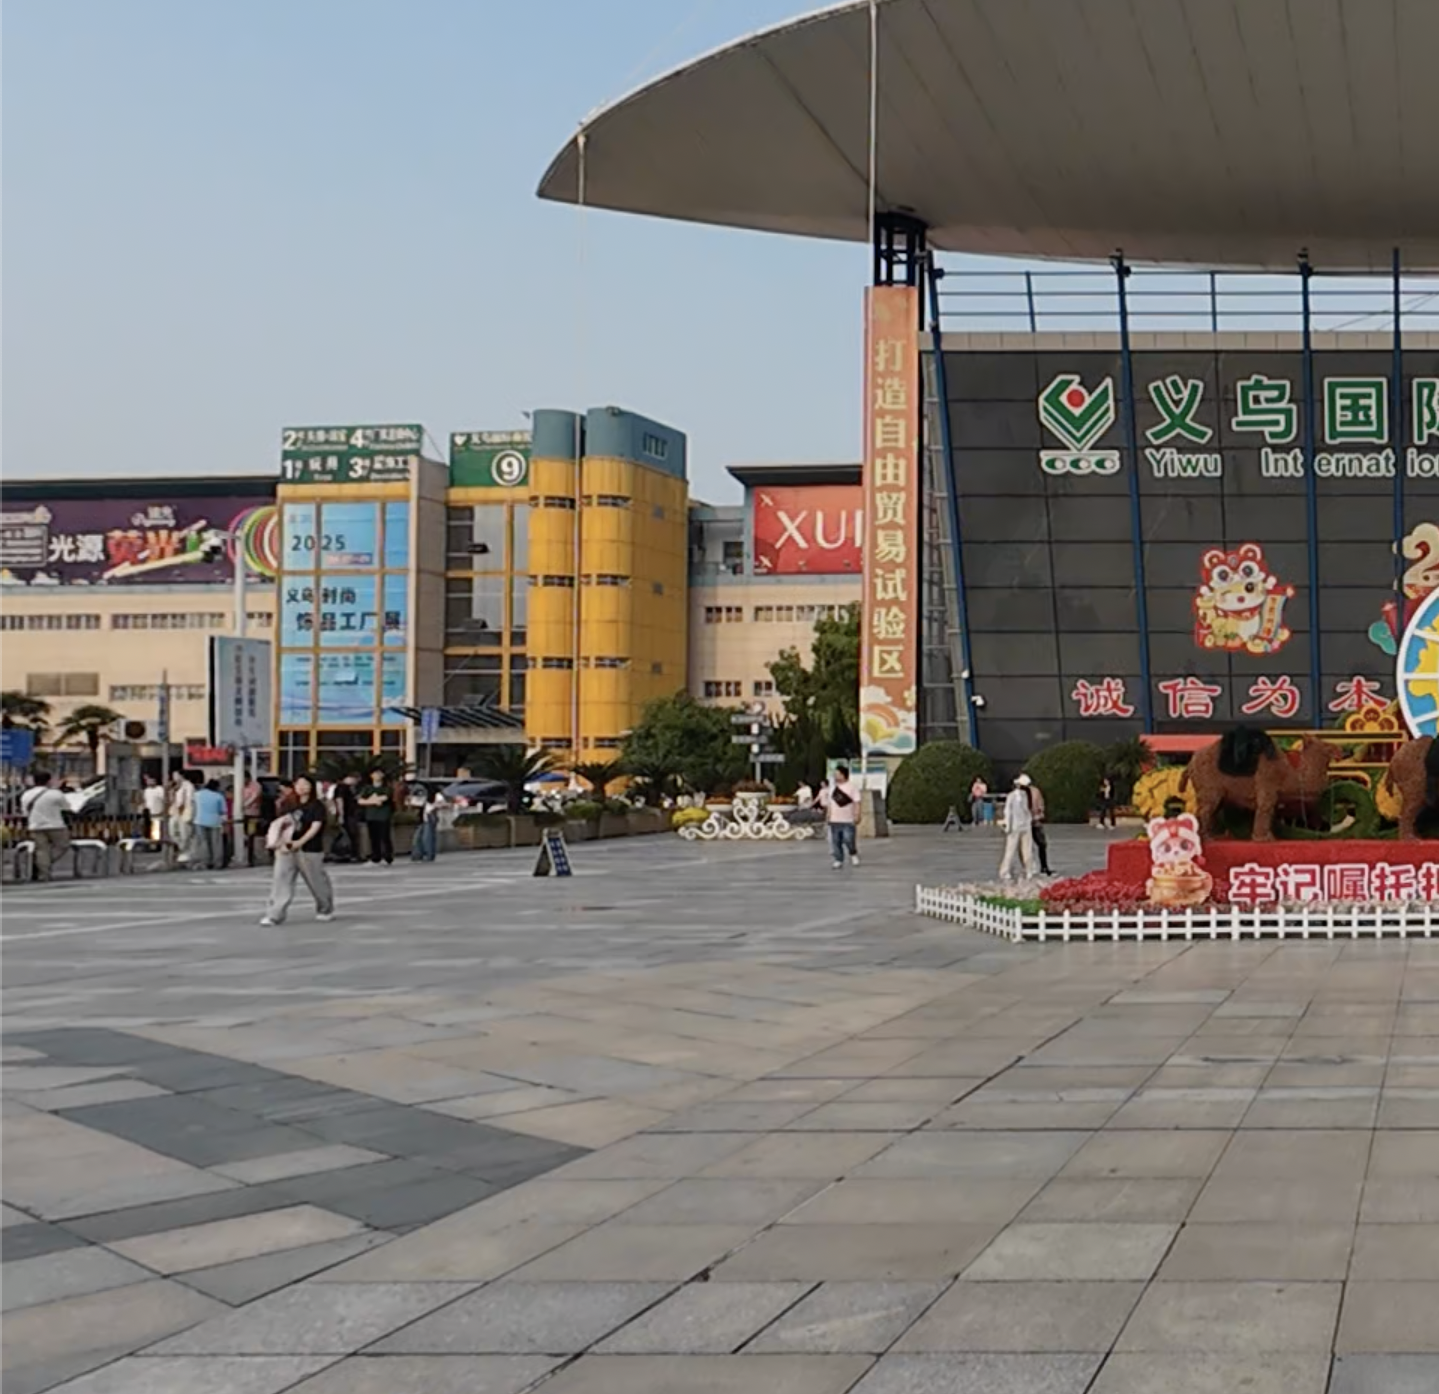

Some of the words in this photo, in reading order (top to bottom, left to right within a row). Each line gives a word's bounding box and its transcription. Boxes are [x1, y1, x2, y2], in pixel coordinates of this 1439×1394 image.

[1145, 447, 1222, 478] Yiwu
[872, 338, 908, 679] 打造自由贸易试验区
[291, 534, 346, 552] 2025
[1072, 674, 1389, 718] 诚信为本
